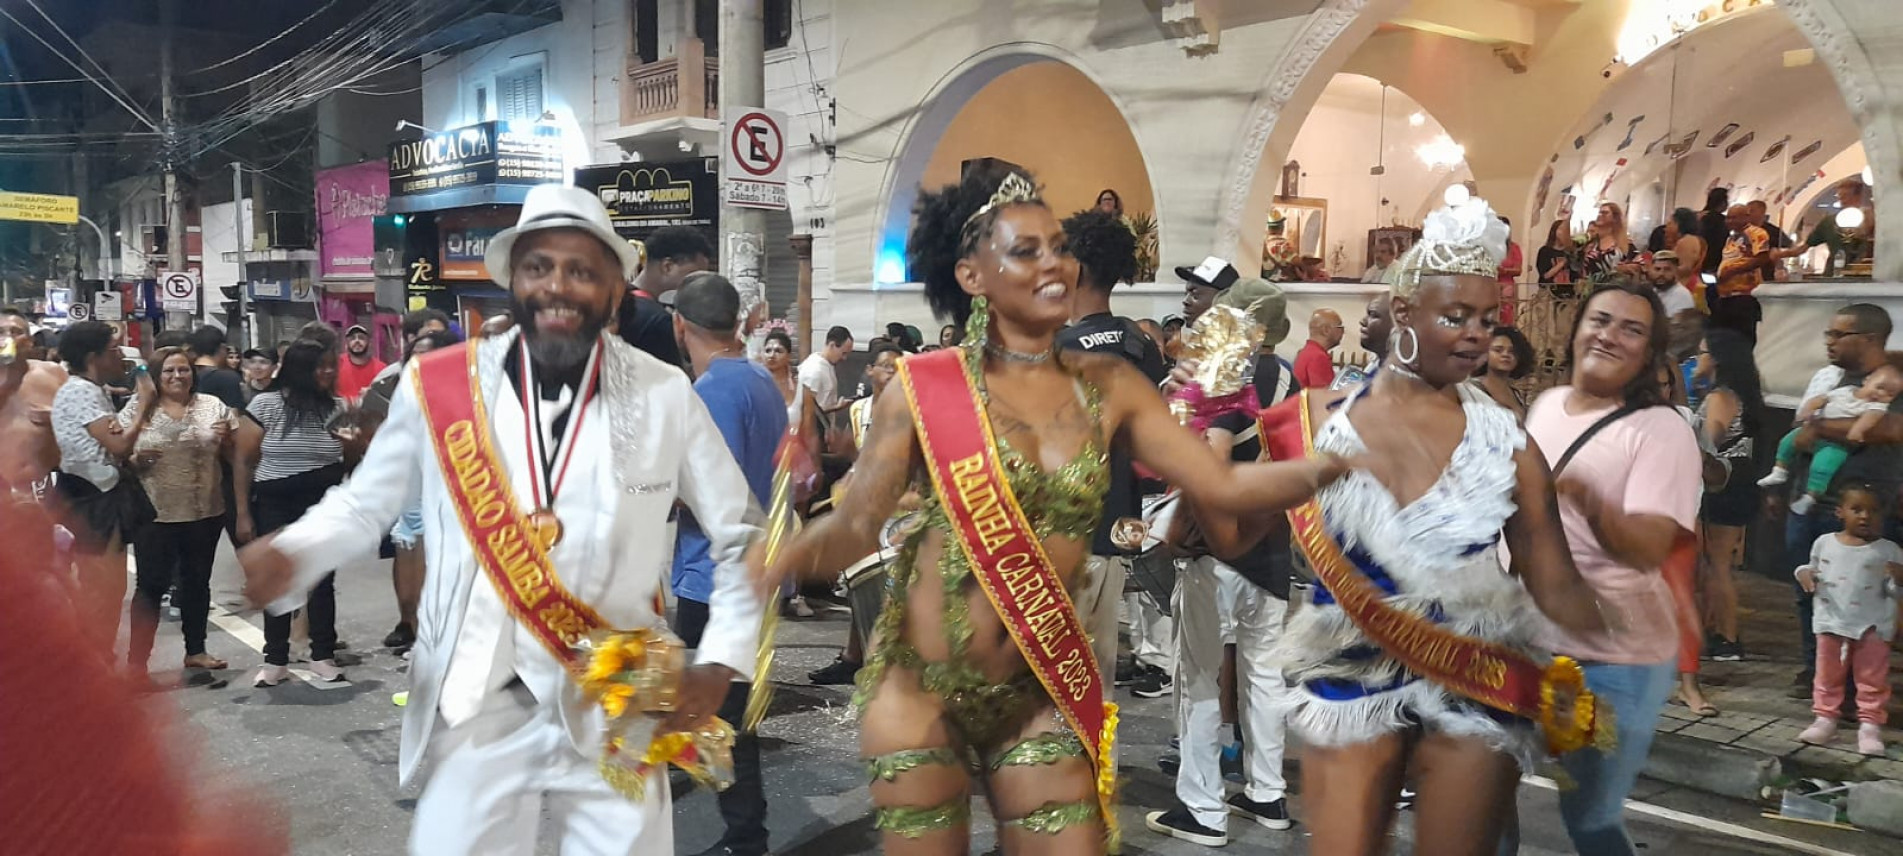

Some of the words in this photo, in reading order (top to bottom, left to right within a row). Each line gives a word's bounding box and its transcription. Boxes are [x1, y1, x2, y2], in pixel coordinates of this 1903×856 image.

[390, 128, 490, 170] ADVOCACIA
[487, 523, 550, 610] SAMBA
[949, 451, 1011, 556] RAINHA
[996, 551, 1071, 661] CARNAVAL
[1055, 648, 1092, 702] 2023
